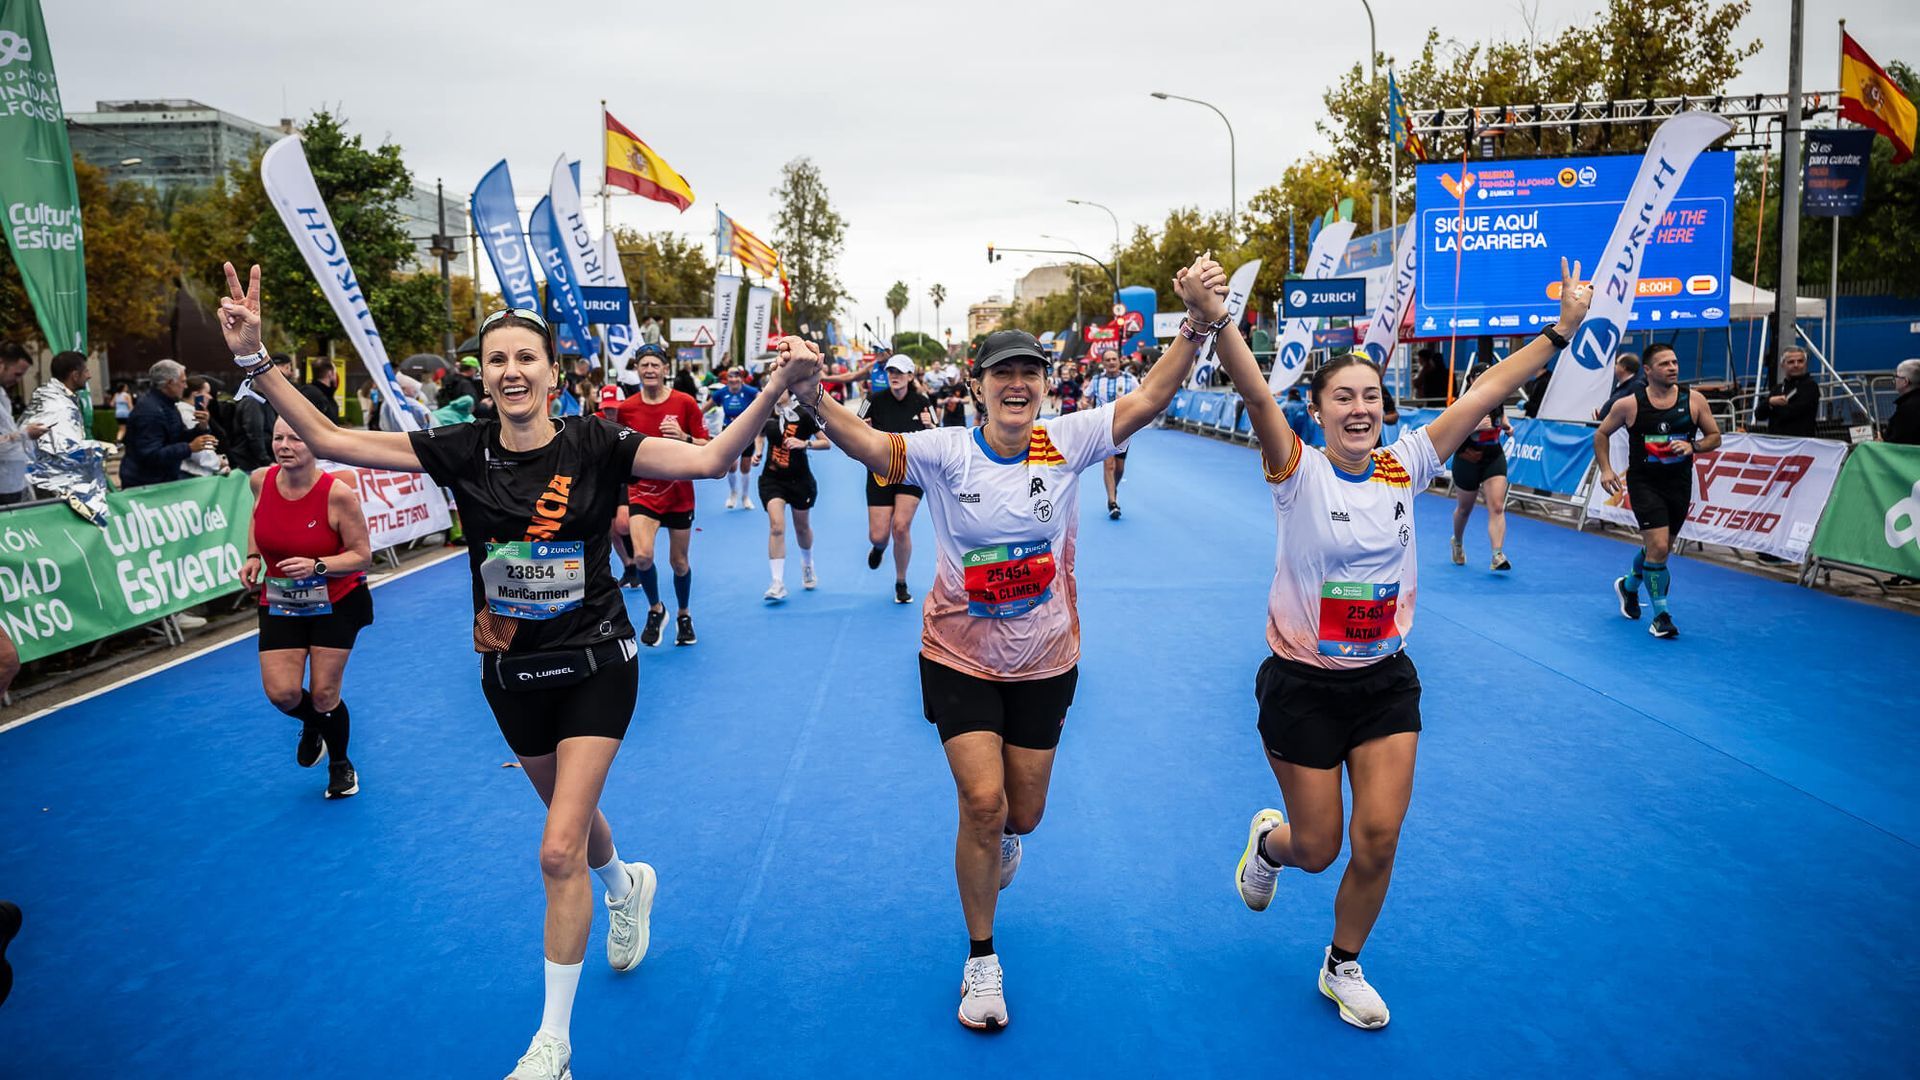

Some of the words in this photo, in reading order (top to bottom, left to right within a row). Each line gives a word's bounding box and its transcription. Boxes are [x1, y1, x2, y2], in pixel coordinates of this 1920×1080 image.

[1808, 155, 1829, 167] para
[1517, 178, 1555, 187] ALFONSO
[1434, 216, 1490, 234] SIGUE
[1494, 210, 1539, 232] AQUÍ
[1679, 209, 1708, 225] THE
[1606, 157, 1676, 304] ZURIH
[1656, 228, 1697, 244] HERE
[1435, 236, 1458, 252] LA
[1461, 232, 1548, 251] CARRERA
[1312, 291, 1357, 304] ZURICH
[203, 504, 229, 533] del
[116, 542, 243, 616] Esfuerzo
[506, 565, 555, 580] 23854
[986, 563, 1031, 583] 25454
[498, 585, 569, 601] MariCarmen
[998, 582, 1041, 600] CLIMEN
[536, 667, 575, 678] LURBEL
